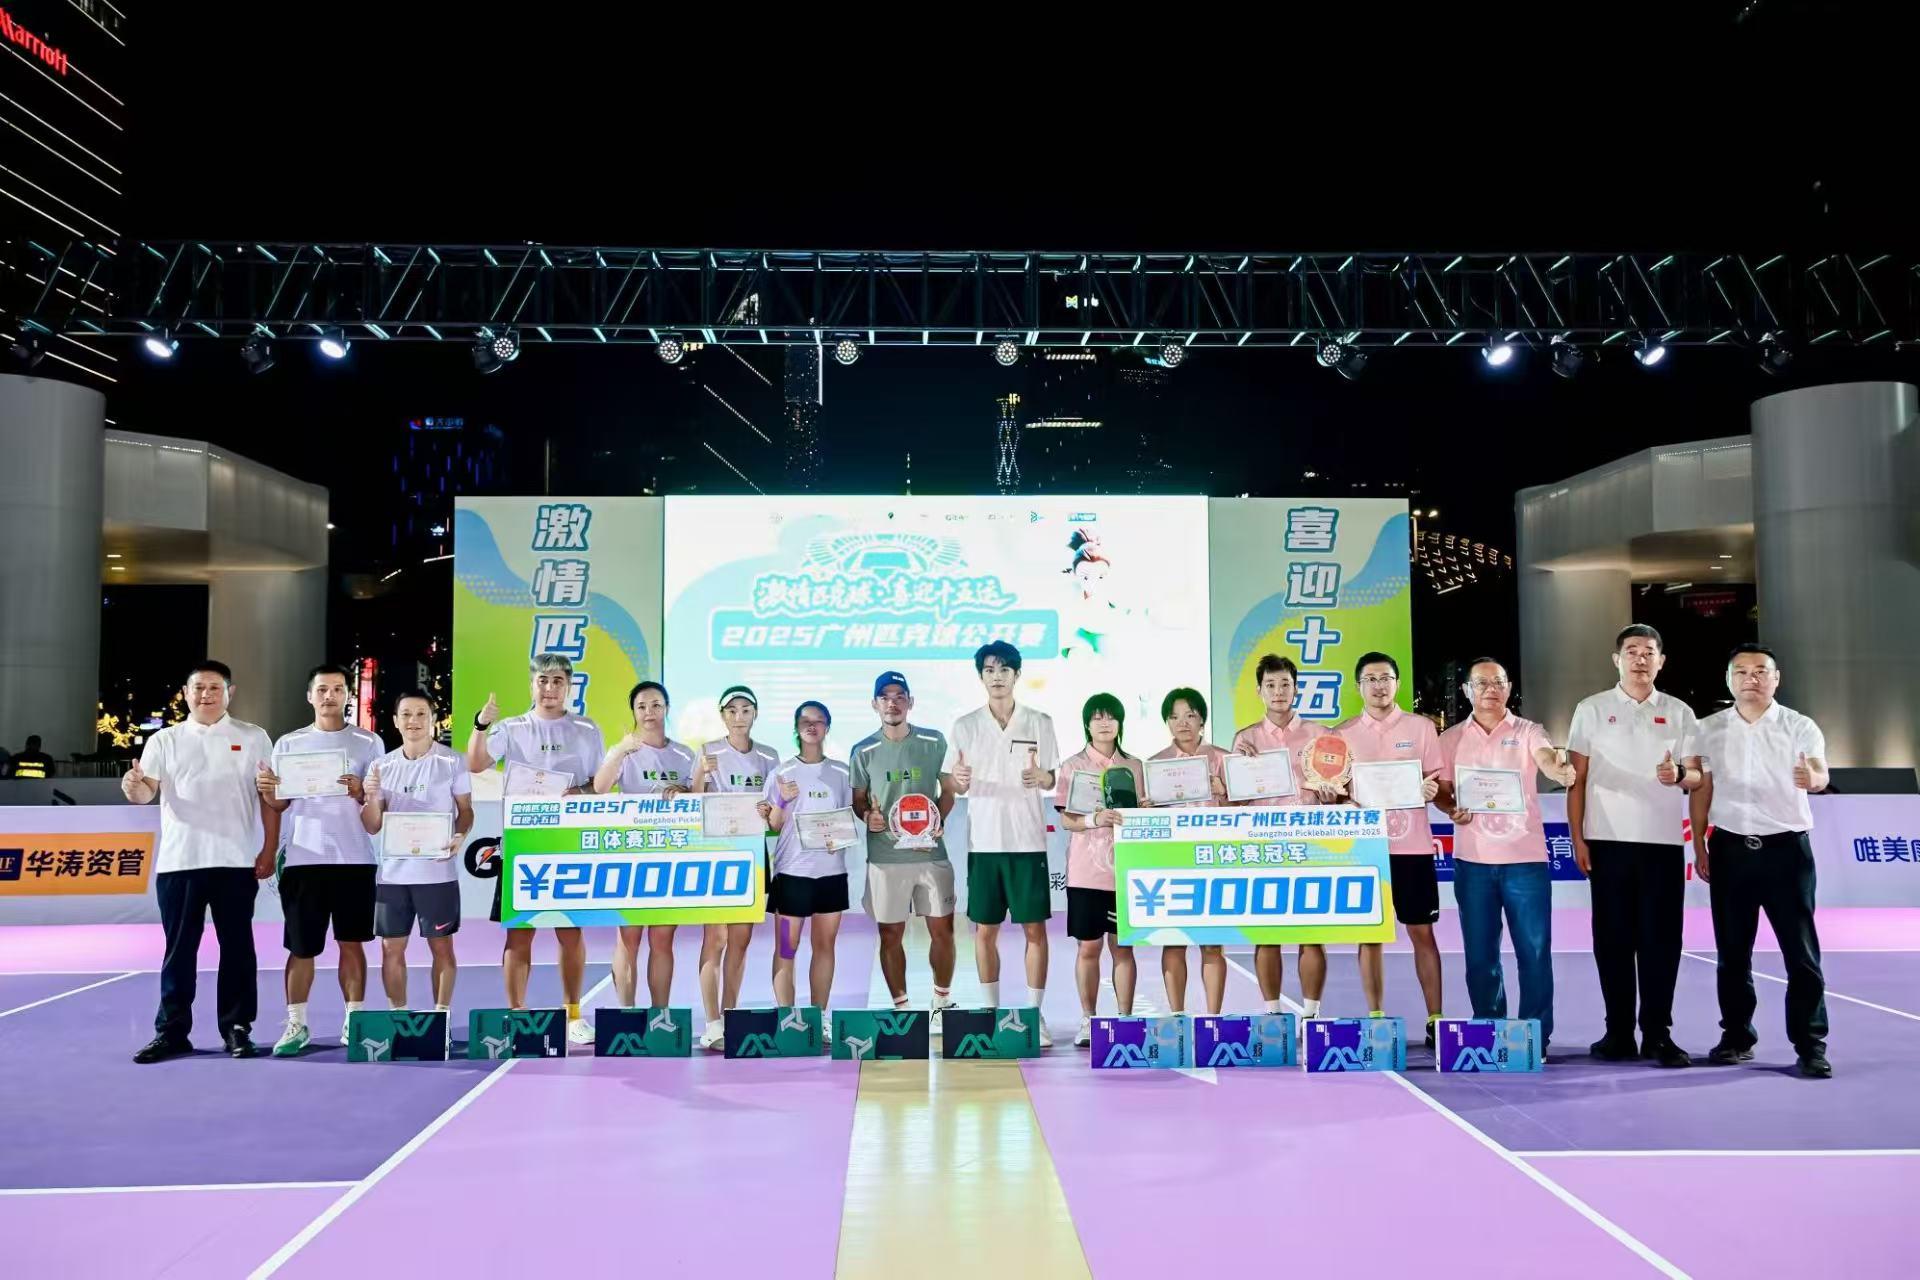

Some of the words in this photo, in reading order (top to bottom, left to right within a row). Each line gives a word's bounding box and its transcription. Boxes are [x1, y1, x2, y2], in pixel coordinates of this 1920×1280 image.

[1176, 810, 1381, 828] 2025广州匹克球公开赛
[581, 829, 689, 850] 团体赛亚军
[1295, 829, 1336, 837] Pickleball
[1337, 829, 1360, 837] Open
[1361, 828, 1381, 836] 2025
[25, 848, 146, 877] 华涛资管
[1194, 843, 1309, 865] 团体赛冠军
[519, 860, 751, 900] ¥20000
[1131, 875, 1375, 917] ¥30000
